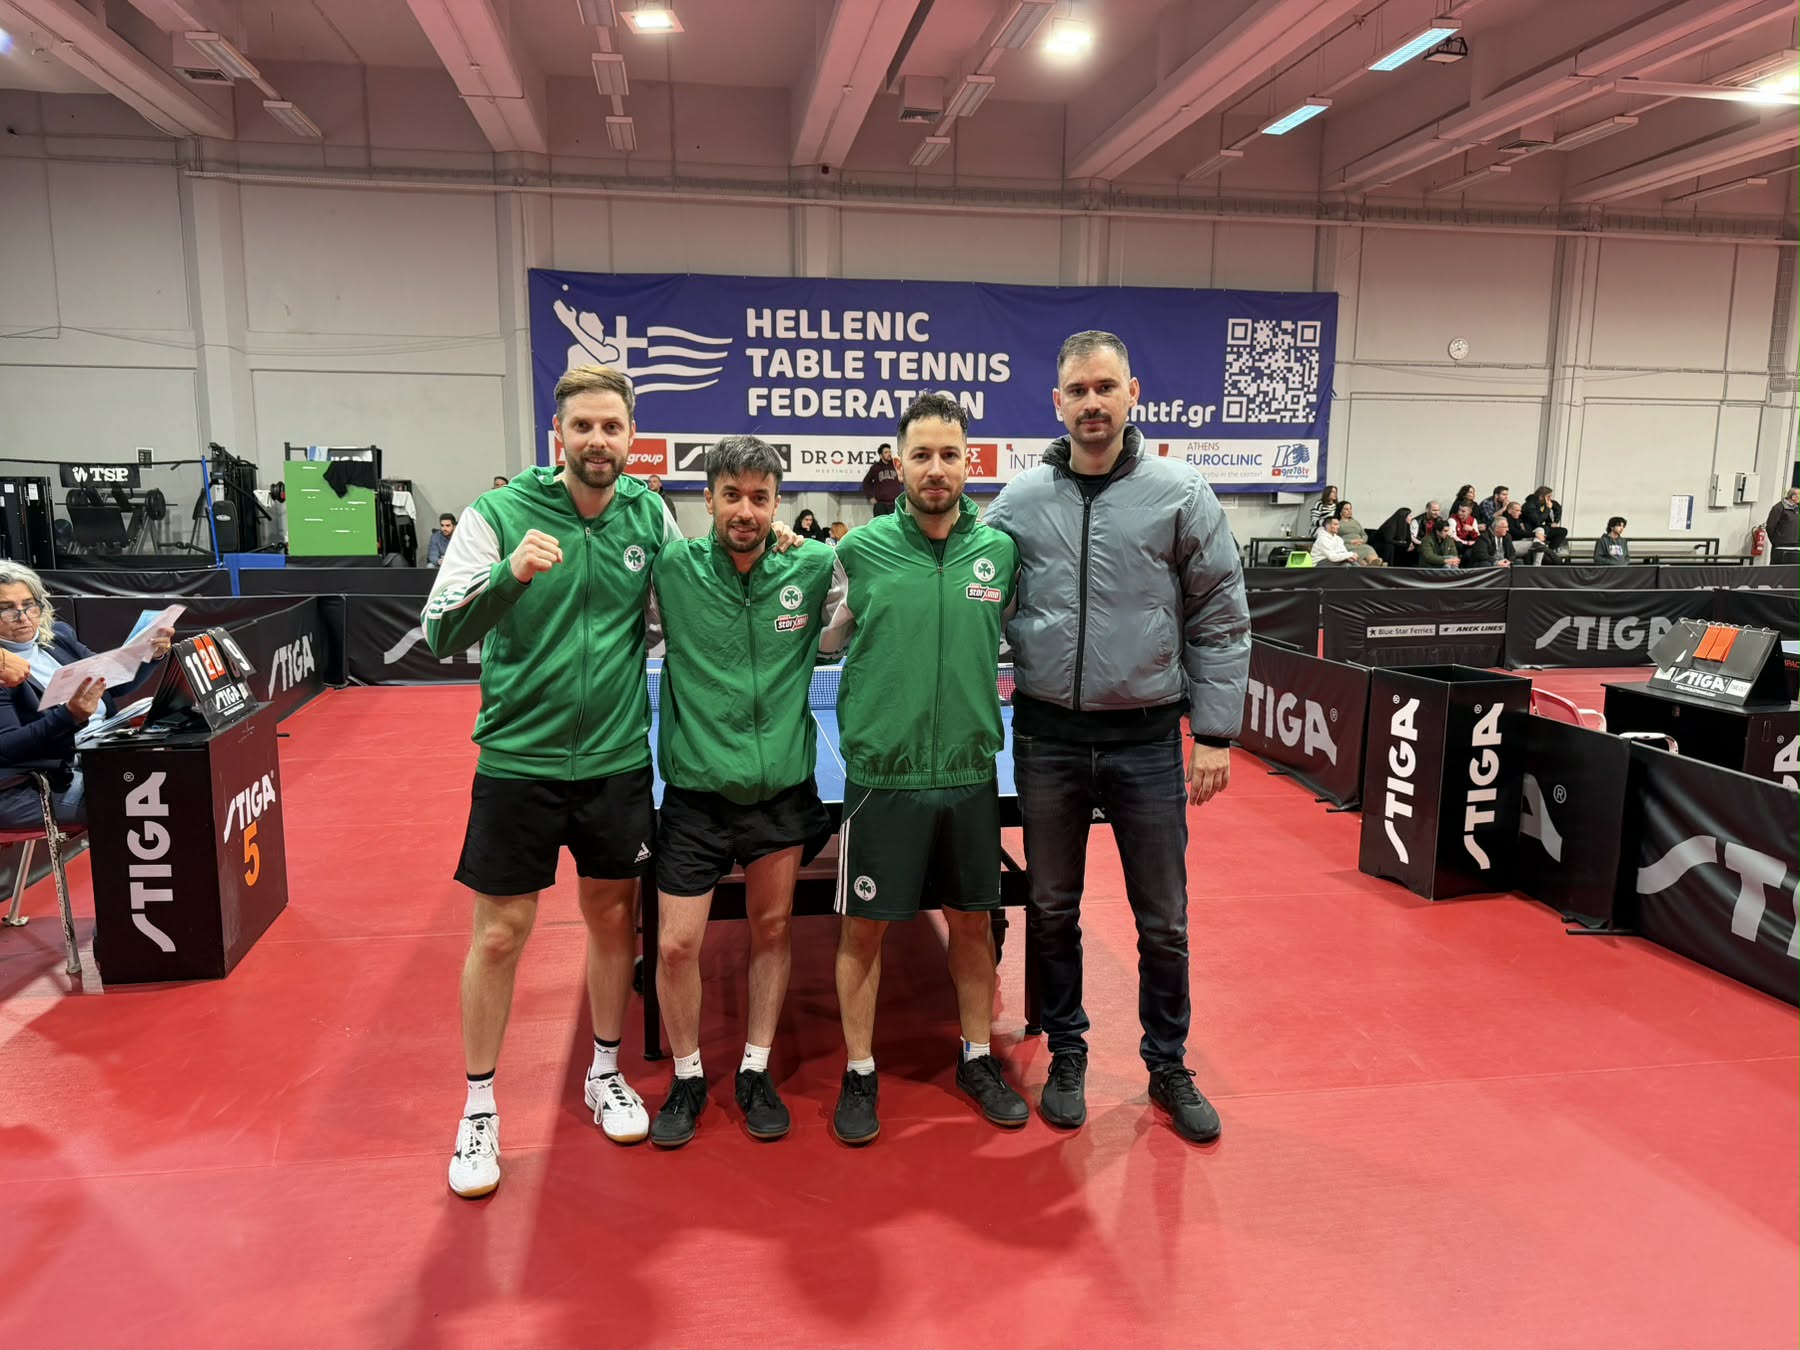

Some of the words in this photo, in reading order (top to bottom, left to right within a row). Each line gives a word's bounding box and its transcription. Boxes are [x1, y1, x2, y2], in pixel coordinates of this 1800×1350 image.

[746, 308, 930, 342] HELLENIC
[745, 348, 865, 379] TABLE
[874, 351, 1011, 382] TENNIS
[748, 387, 984, 420] FEDERATN
[627, 452, 664, 465] group
[1186, 454, 1263, 466] EUROCLINIC
[1187, 442, 1220, 451] ATHENS
[1378, 627, 1393, 635] Blue
[1395, 626, 1408, 635] Star
[1410, 626, 1434, 635] Ferries
[1480, 624, 1504, 632] LINES
[268, 635, 315, 700] STIGA
[1673, 671, 1728, 692] STIGA
[215, 684, 242, 711] STIGA
[1248, 678, 1338, 767] TIGA
[1384, 698, 1420, 865] STIGA
[1463, 702, 1505, 870] STIGA
[223, 774, 276, 844] STIGA
[125, 772, 177, 952] STIGA
[243, 821, 260, 887] 5
